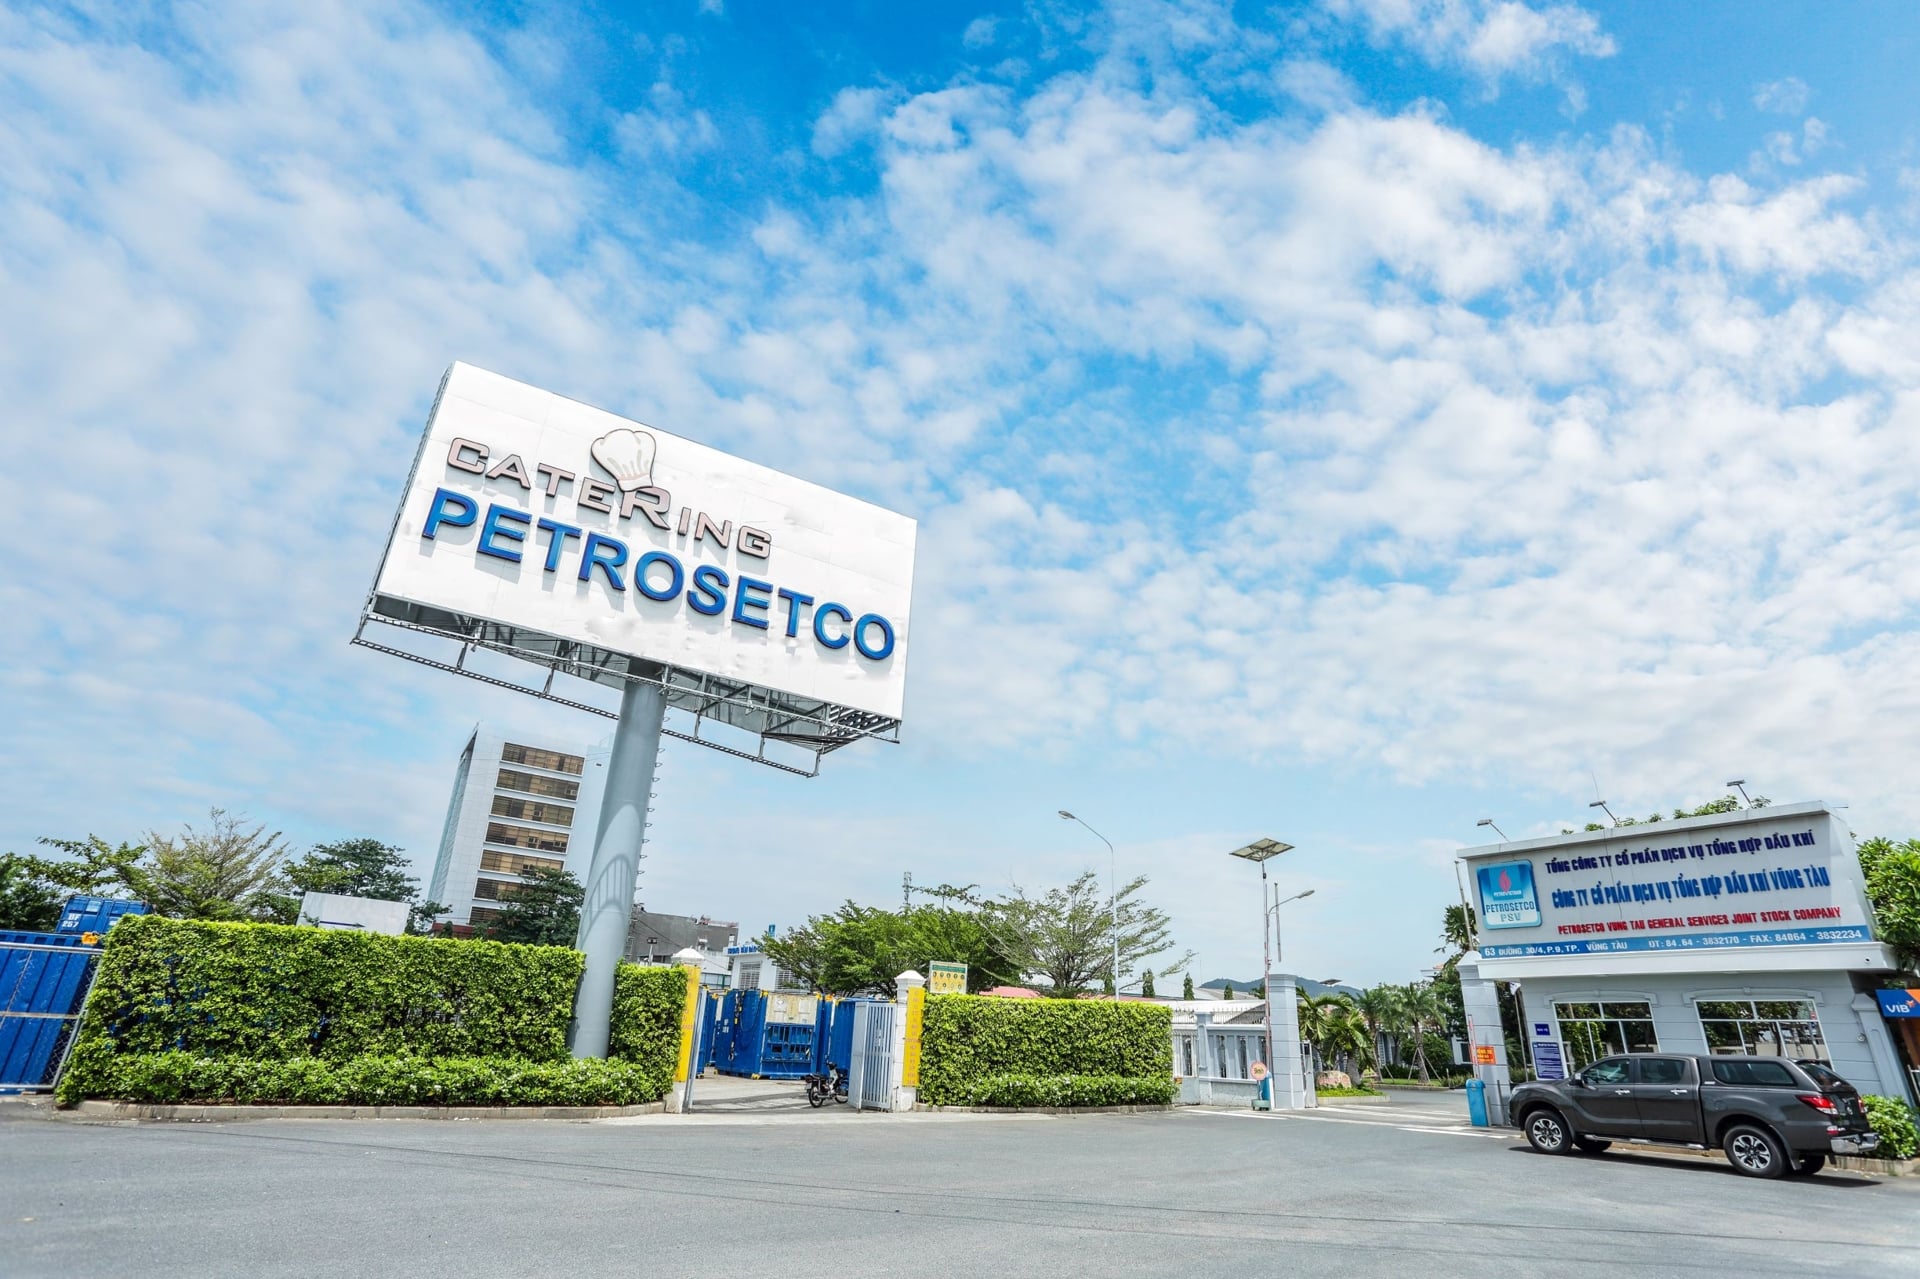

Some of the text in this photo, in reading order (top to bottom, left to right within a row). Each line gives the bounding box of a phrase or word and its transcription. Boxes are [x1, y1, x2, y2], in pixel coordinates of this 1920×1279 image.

[447, 437, 772, 559] CATERING
[422, 487, 895, 660] PETROSETCO
[1545, 857, 1571, 874] TỔNG
[1572, 856, 1598, 871] CÔNG
[1598, 855, 1612, 868] TY
[1615, 848, 1630, 866] CỔ
[1660, 847, 1687, 864] DỊCH
[1687, 845, 1705, 860] VỤ
[1705, 838, 1737, 857] TỔNG
[1738, 837, 1762, 854] HỢP
[1791, 829, 1815, 847] KHÍ
[1552, 888, 1577, 909] CÔNG
[1576, 889, 1589, 906] TY
[1590, 881, 1605, 905] CỔ
[1632, 883, 1656, 905] DỊCH
[1656, 881, 1672, 902] VỤ
[1672, 873, 1702, 899] TỔNG
[1701, 874, 1723, 899] HỢP
[1748, 868, 1771, 892] KHÍ
[1770, 867, 1805, 890] VŨNG
[1803, 864, 1831, 888] TÀU
[1485, 901, 1535, 913] PETROSETCO
[1500, 913, 1521, 922] PSV
[1558, 906, 1841, 935] PETROSETCO VUNG TAU GENERAL SERVICES JOINT STOCK COMPANY
[1484, 947, 1496, 957] 63
[1586, 941, 1609, 951] VŨNG
[1611, 940, 1628, 950] TÀU
[1702, 935, 1740, 946] 3832170
[1749, 934, 1773, 943] FAX:
[1816, 929, 1863, 940] 3832234
[1885, 1004, 1910, 1013] VIB
